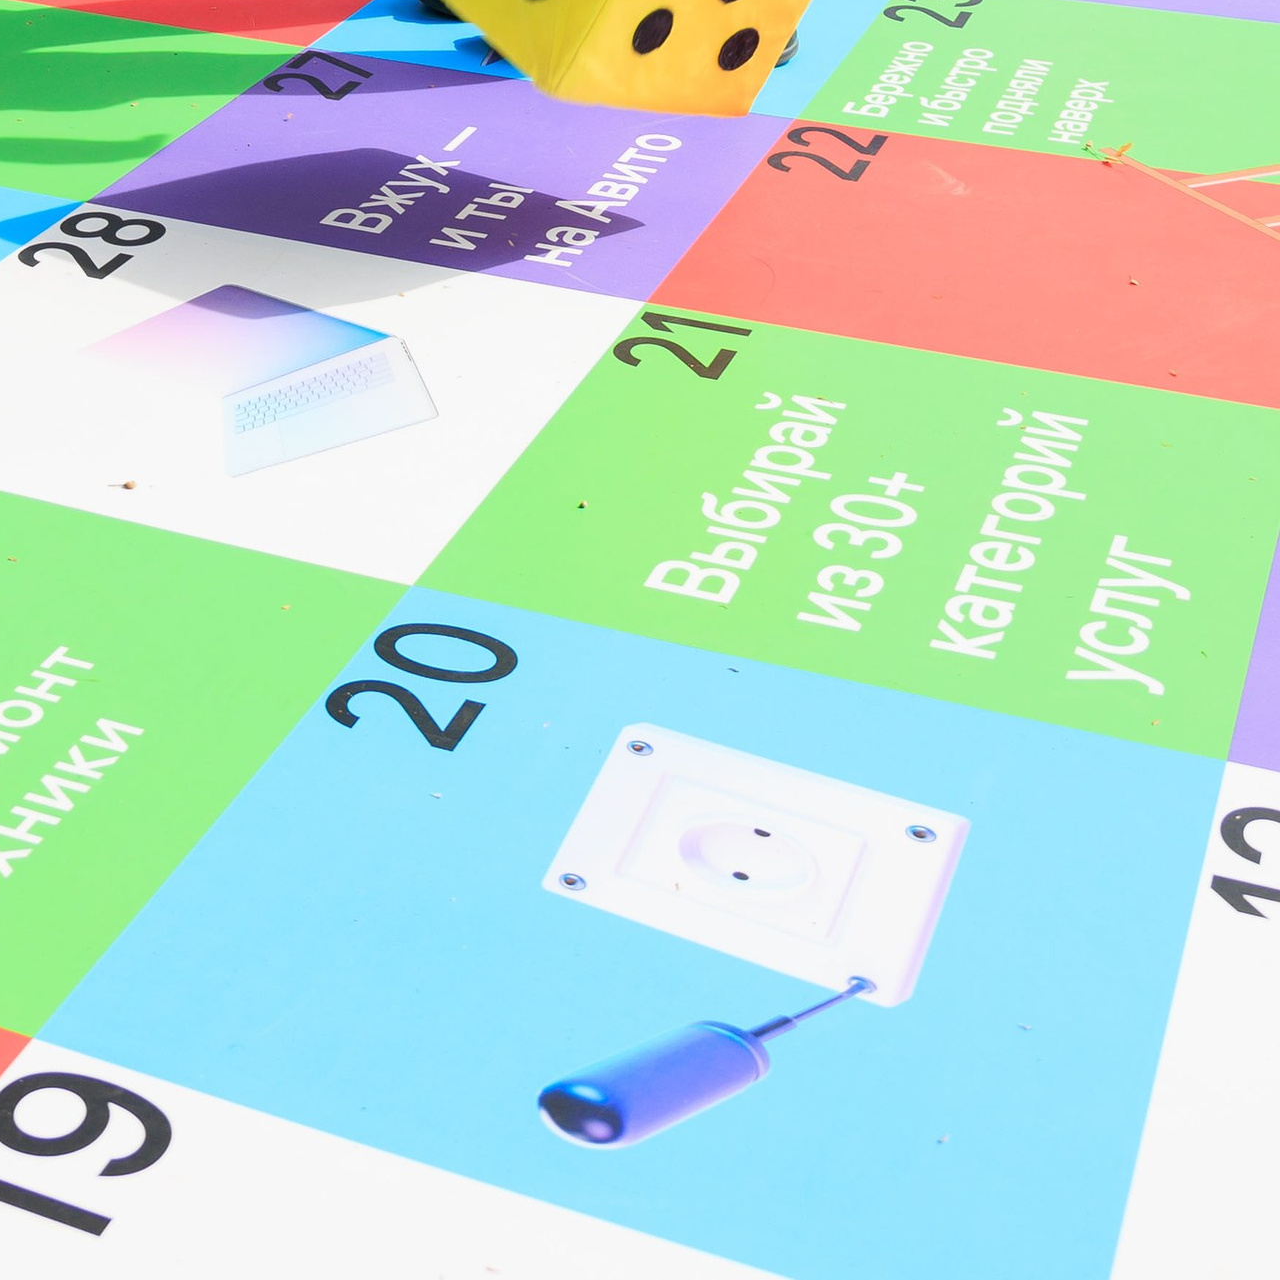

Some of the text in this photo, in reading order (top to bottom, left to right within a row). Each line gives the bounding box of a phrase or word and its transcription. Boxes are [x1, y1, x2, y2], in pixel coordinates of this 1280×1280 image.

[263, 50, 373, 102] 27
[842, 41, 934, 118] Бережно
[918, 47, 998, 127] и быстро
[982, 58, 1054, 136] подняли
[1048, 78, 1114, 145] наверх
[767, 125, 889, 182] 22
[319, 154, 461, 235] Вжух
[429, 182, 535, 251] и ты
[523, 133, 683, 268] на Авито
[17, 211, 167, 279] 28
[613, 311, 752, 380] 21
[644, 391, 847, 605] Выбирай
[929, 408, 1089, 660] категорий
[797, 471, 925, 632] из 30+
[1065, 535, 1190, 696] услуг
[325, 623, 518, 751] 20
